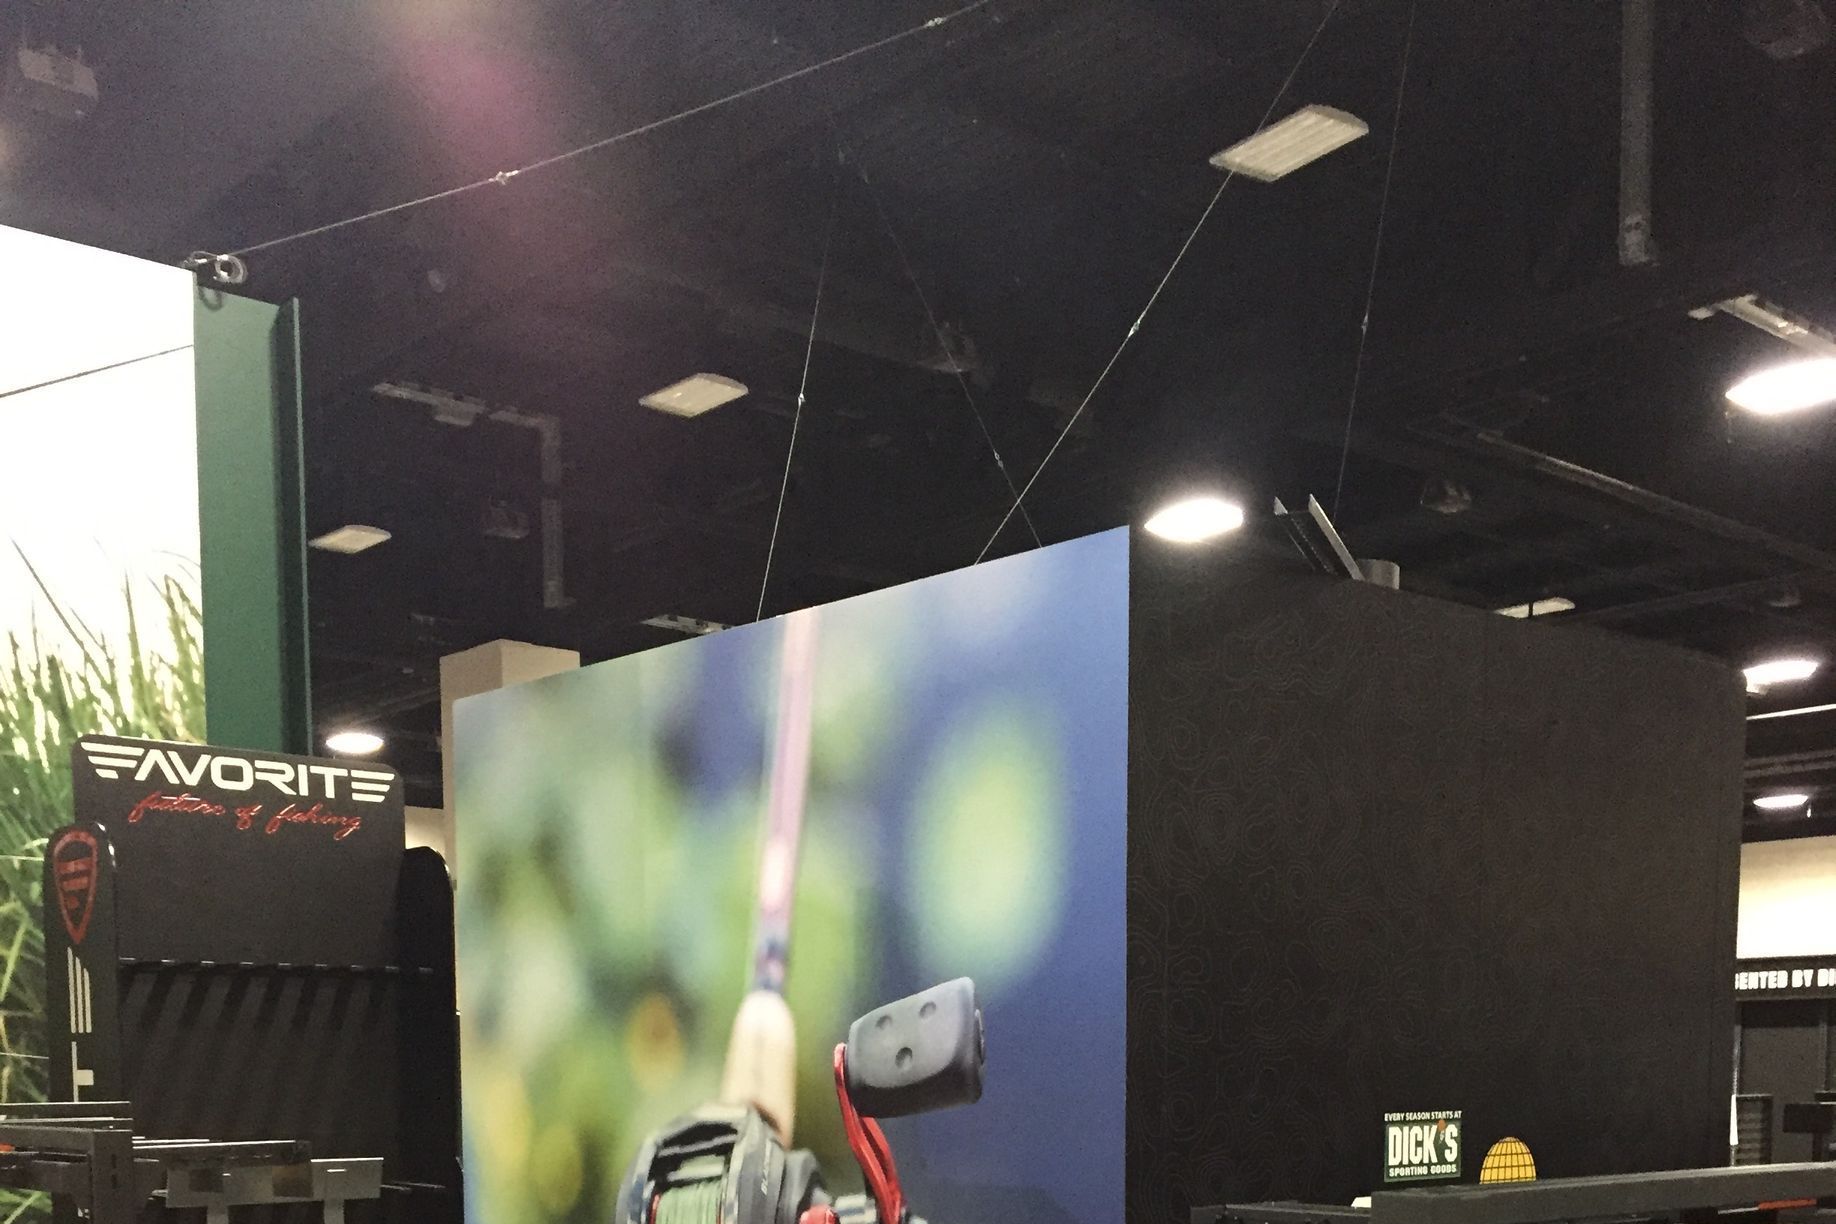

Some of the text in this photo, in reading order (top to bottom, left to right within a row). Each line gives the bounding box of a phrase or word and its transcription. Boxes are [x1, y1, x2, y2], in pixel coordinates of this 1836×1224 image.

[81, 742, 395, 802] FAVORITE
[127, 791, 362, 841] future of fishing
[1792, 969, 1814, 988] BY
[1384, 1110, 1462, 1122] EVERY SEASON STARTS AT
[1388, 1124, 1458, 1166] DICK'S
[1389, 1164, 1457, 1177] SPORTING GOODS
